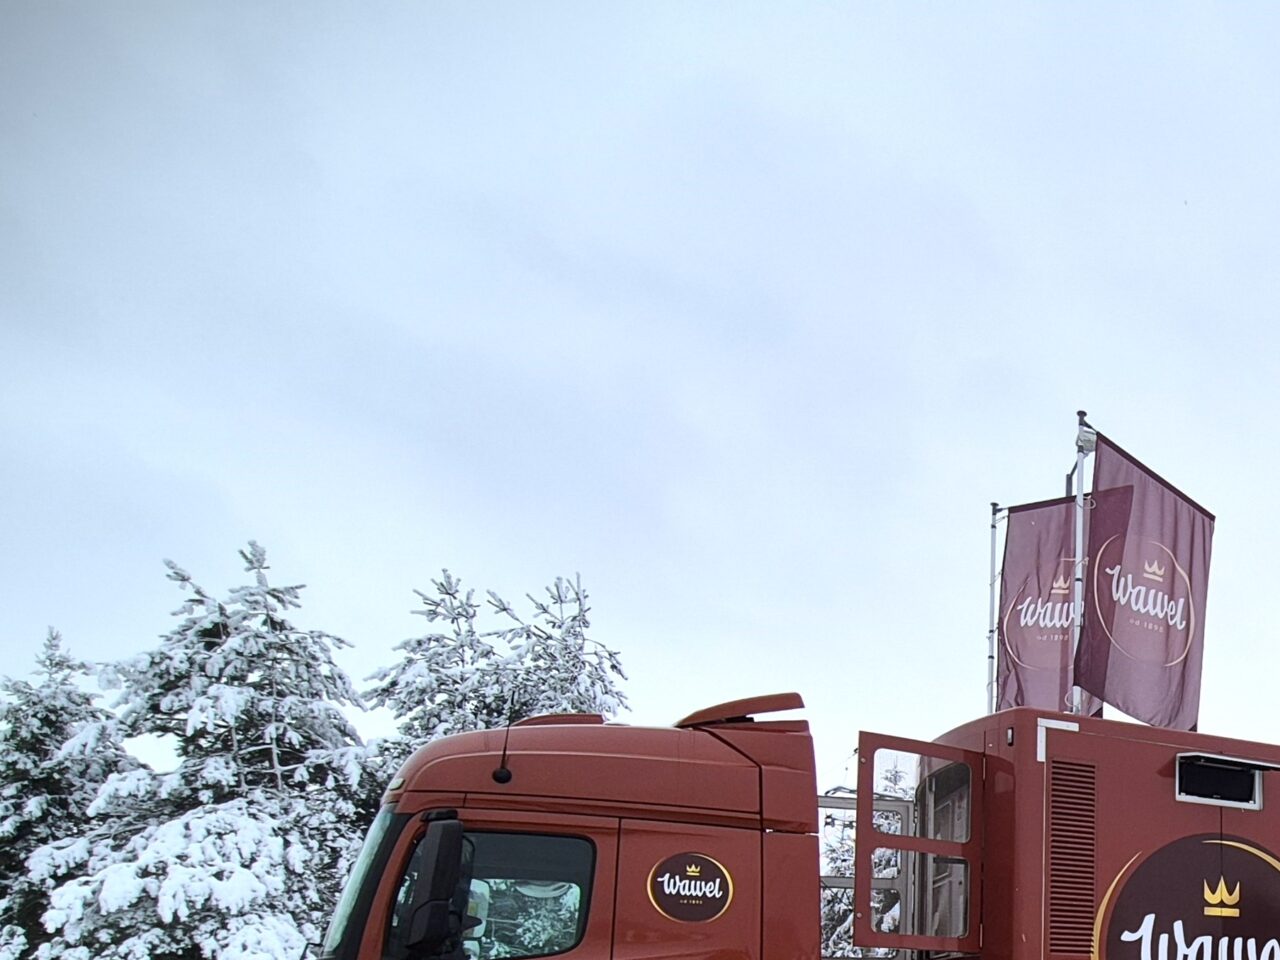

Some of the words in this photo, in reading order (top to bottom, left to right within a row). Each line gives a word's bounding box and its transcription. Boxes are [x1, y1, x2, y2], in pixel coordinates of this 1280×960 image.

[1016, 596, 1084, 628] Waw
[1105, 564, 1187, 630] Wawel
[657, 873, 723, 898] Wawel
